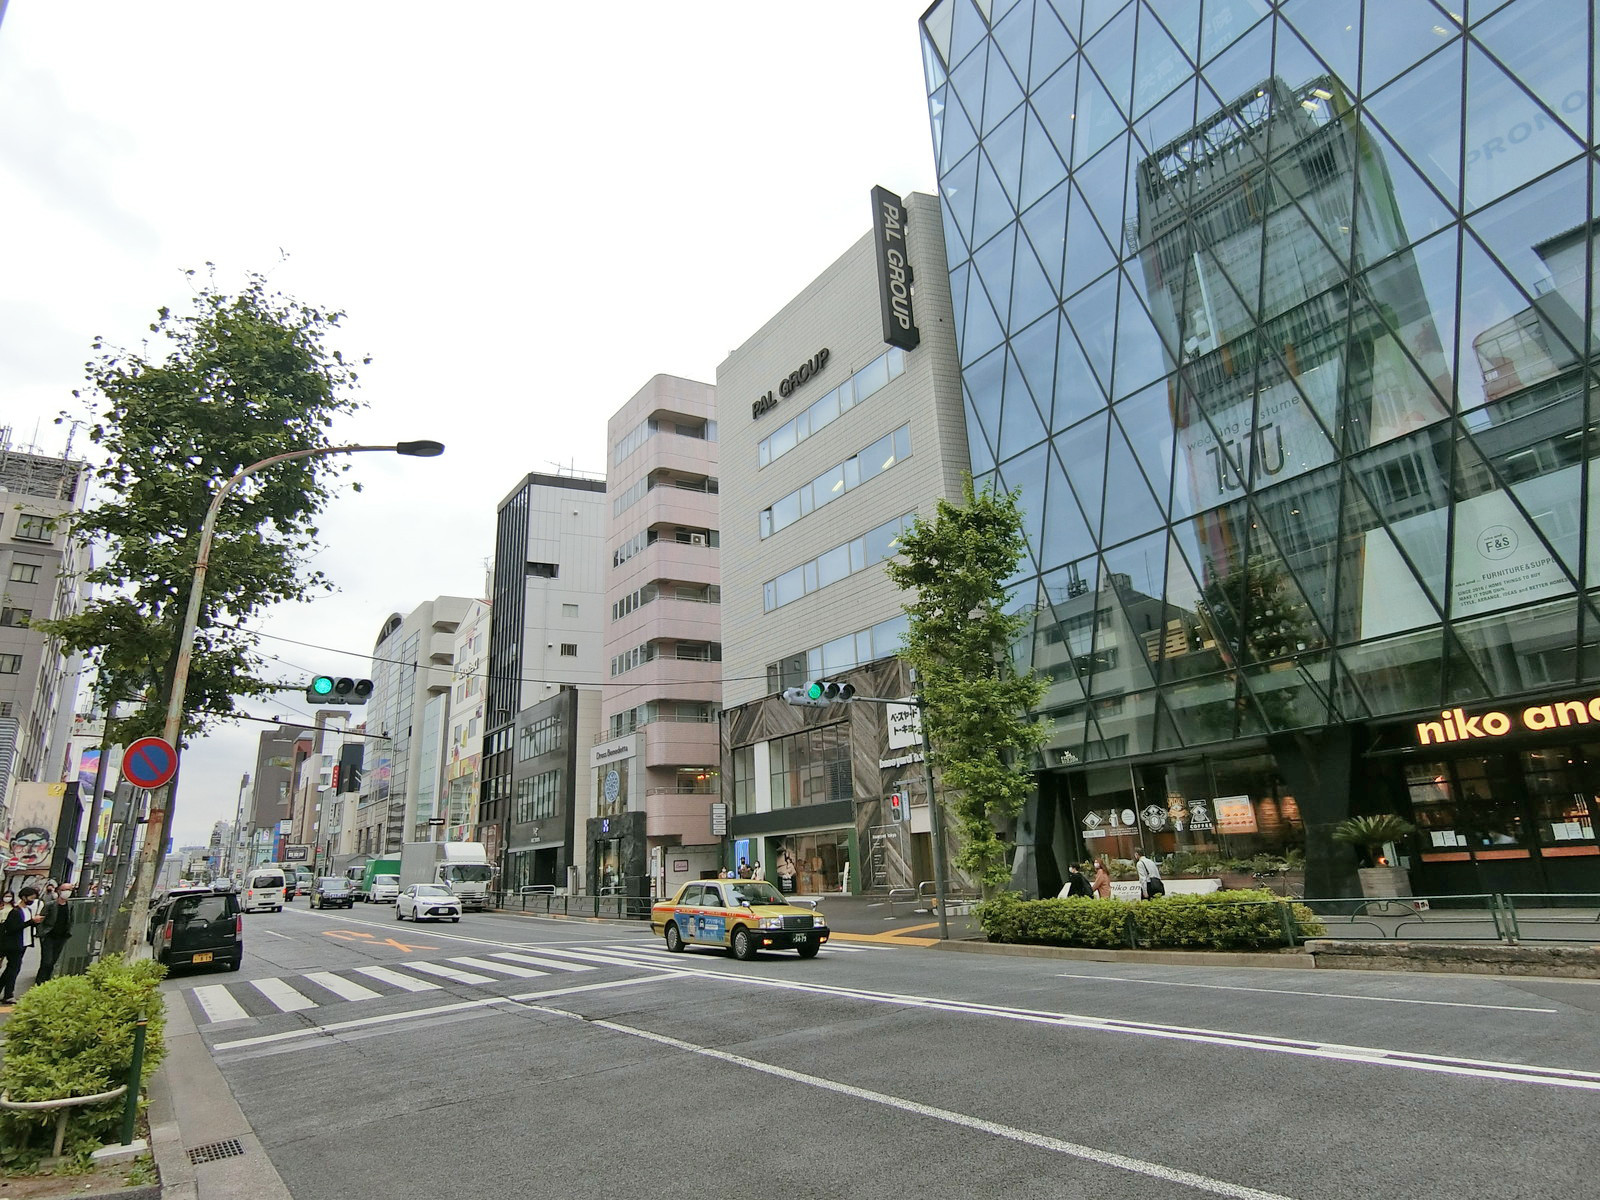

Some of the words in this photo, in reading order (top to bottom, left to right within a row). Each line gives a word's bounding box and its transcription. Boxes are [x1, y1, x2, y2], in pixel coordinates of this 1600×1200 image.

[1467, 87, 1600, 171] PRONO
[883, 201, 902, 242] PAL
[887, 249, 910, 330] GROUP
[751, 390, 778, 420] PAL
[779, 347, 830, 398] GROUP
[1244, 394, 1301, 427] cstume
[1485, 536, 1510, 553] F&S
[1416, 707, 1512, 746] niko
